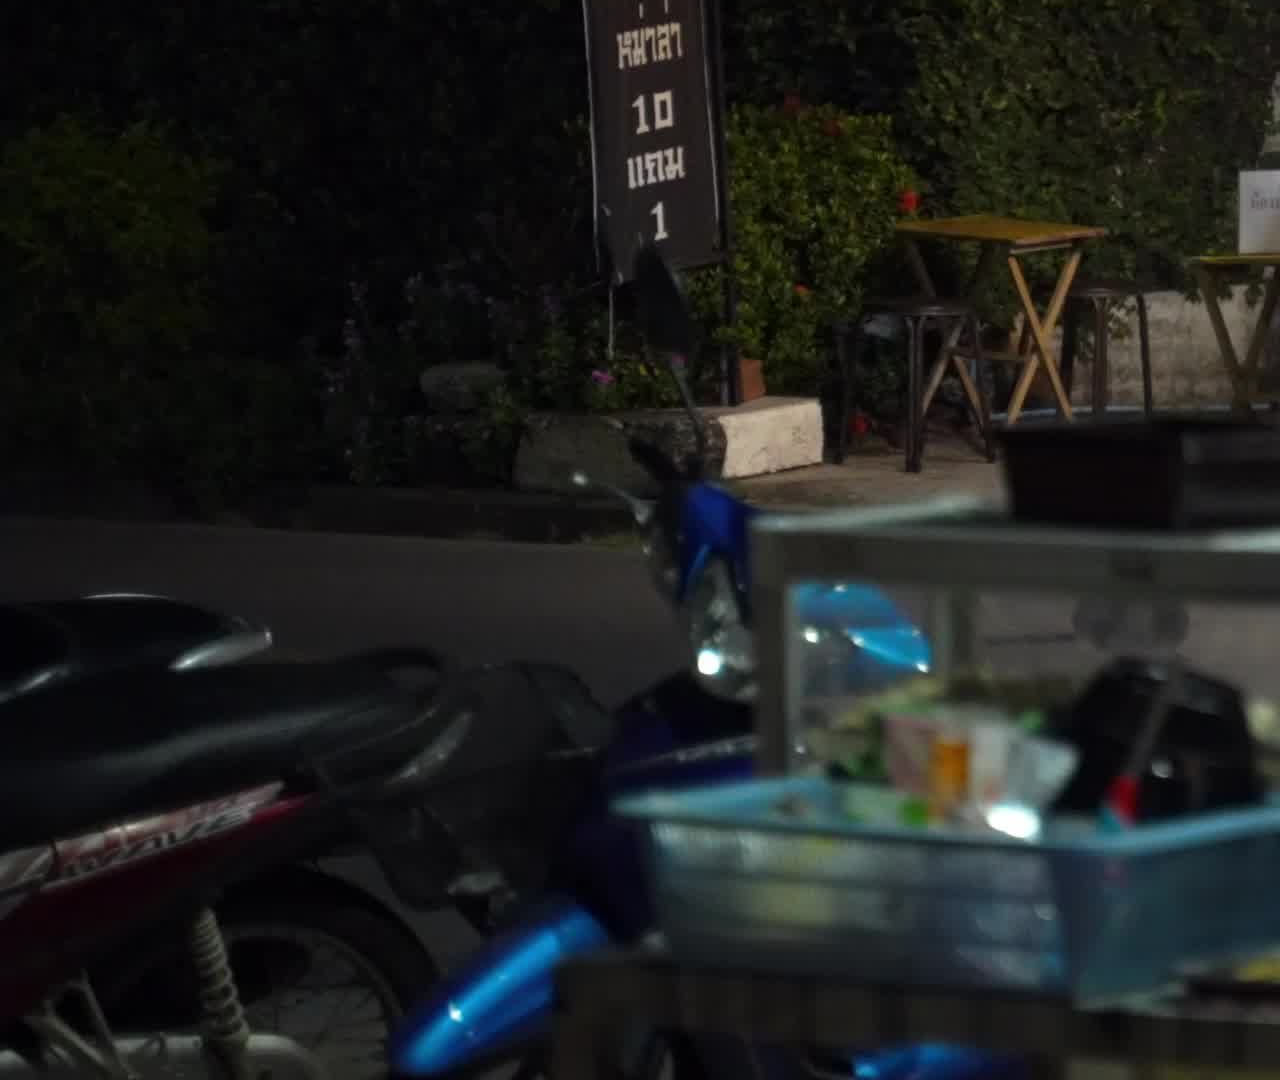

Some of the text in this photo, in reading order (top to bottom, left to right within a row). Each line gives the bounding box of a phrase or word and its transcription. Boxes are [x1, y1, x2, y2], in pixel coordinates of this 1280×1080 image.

[617, 0, 683, 70] หม่าล่า
[632, 91, 674, 136] 10
[626, 145, 686, 190] แถม
[650, 201, 669, 242] 1
